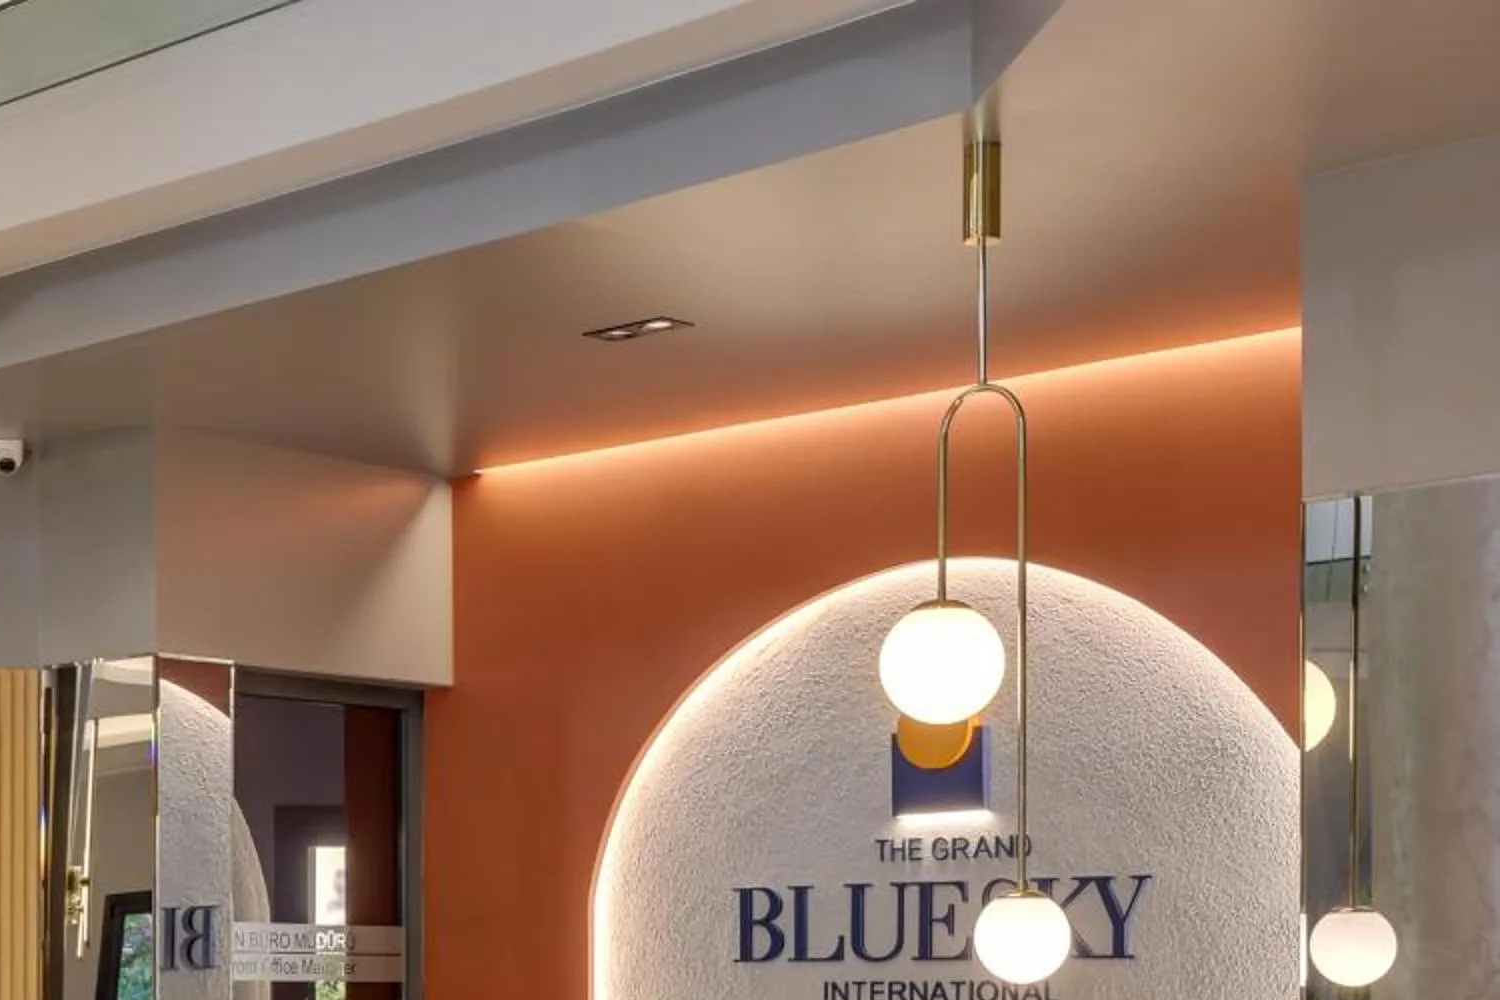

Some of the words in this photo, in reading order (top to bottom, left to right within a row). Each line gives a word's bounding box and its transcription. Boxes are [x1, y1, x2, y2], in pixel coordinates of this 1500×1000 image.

[875, 838, 922, 863] THE
[931, 834, 1032, 861] GRAND
[732, 874, 1153, 964] BLUEKY
